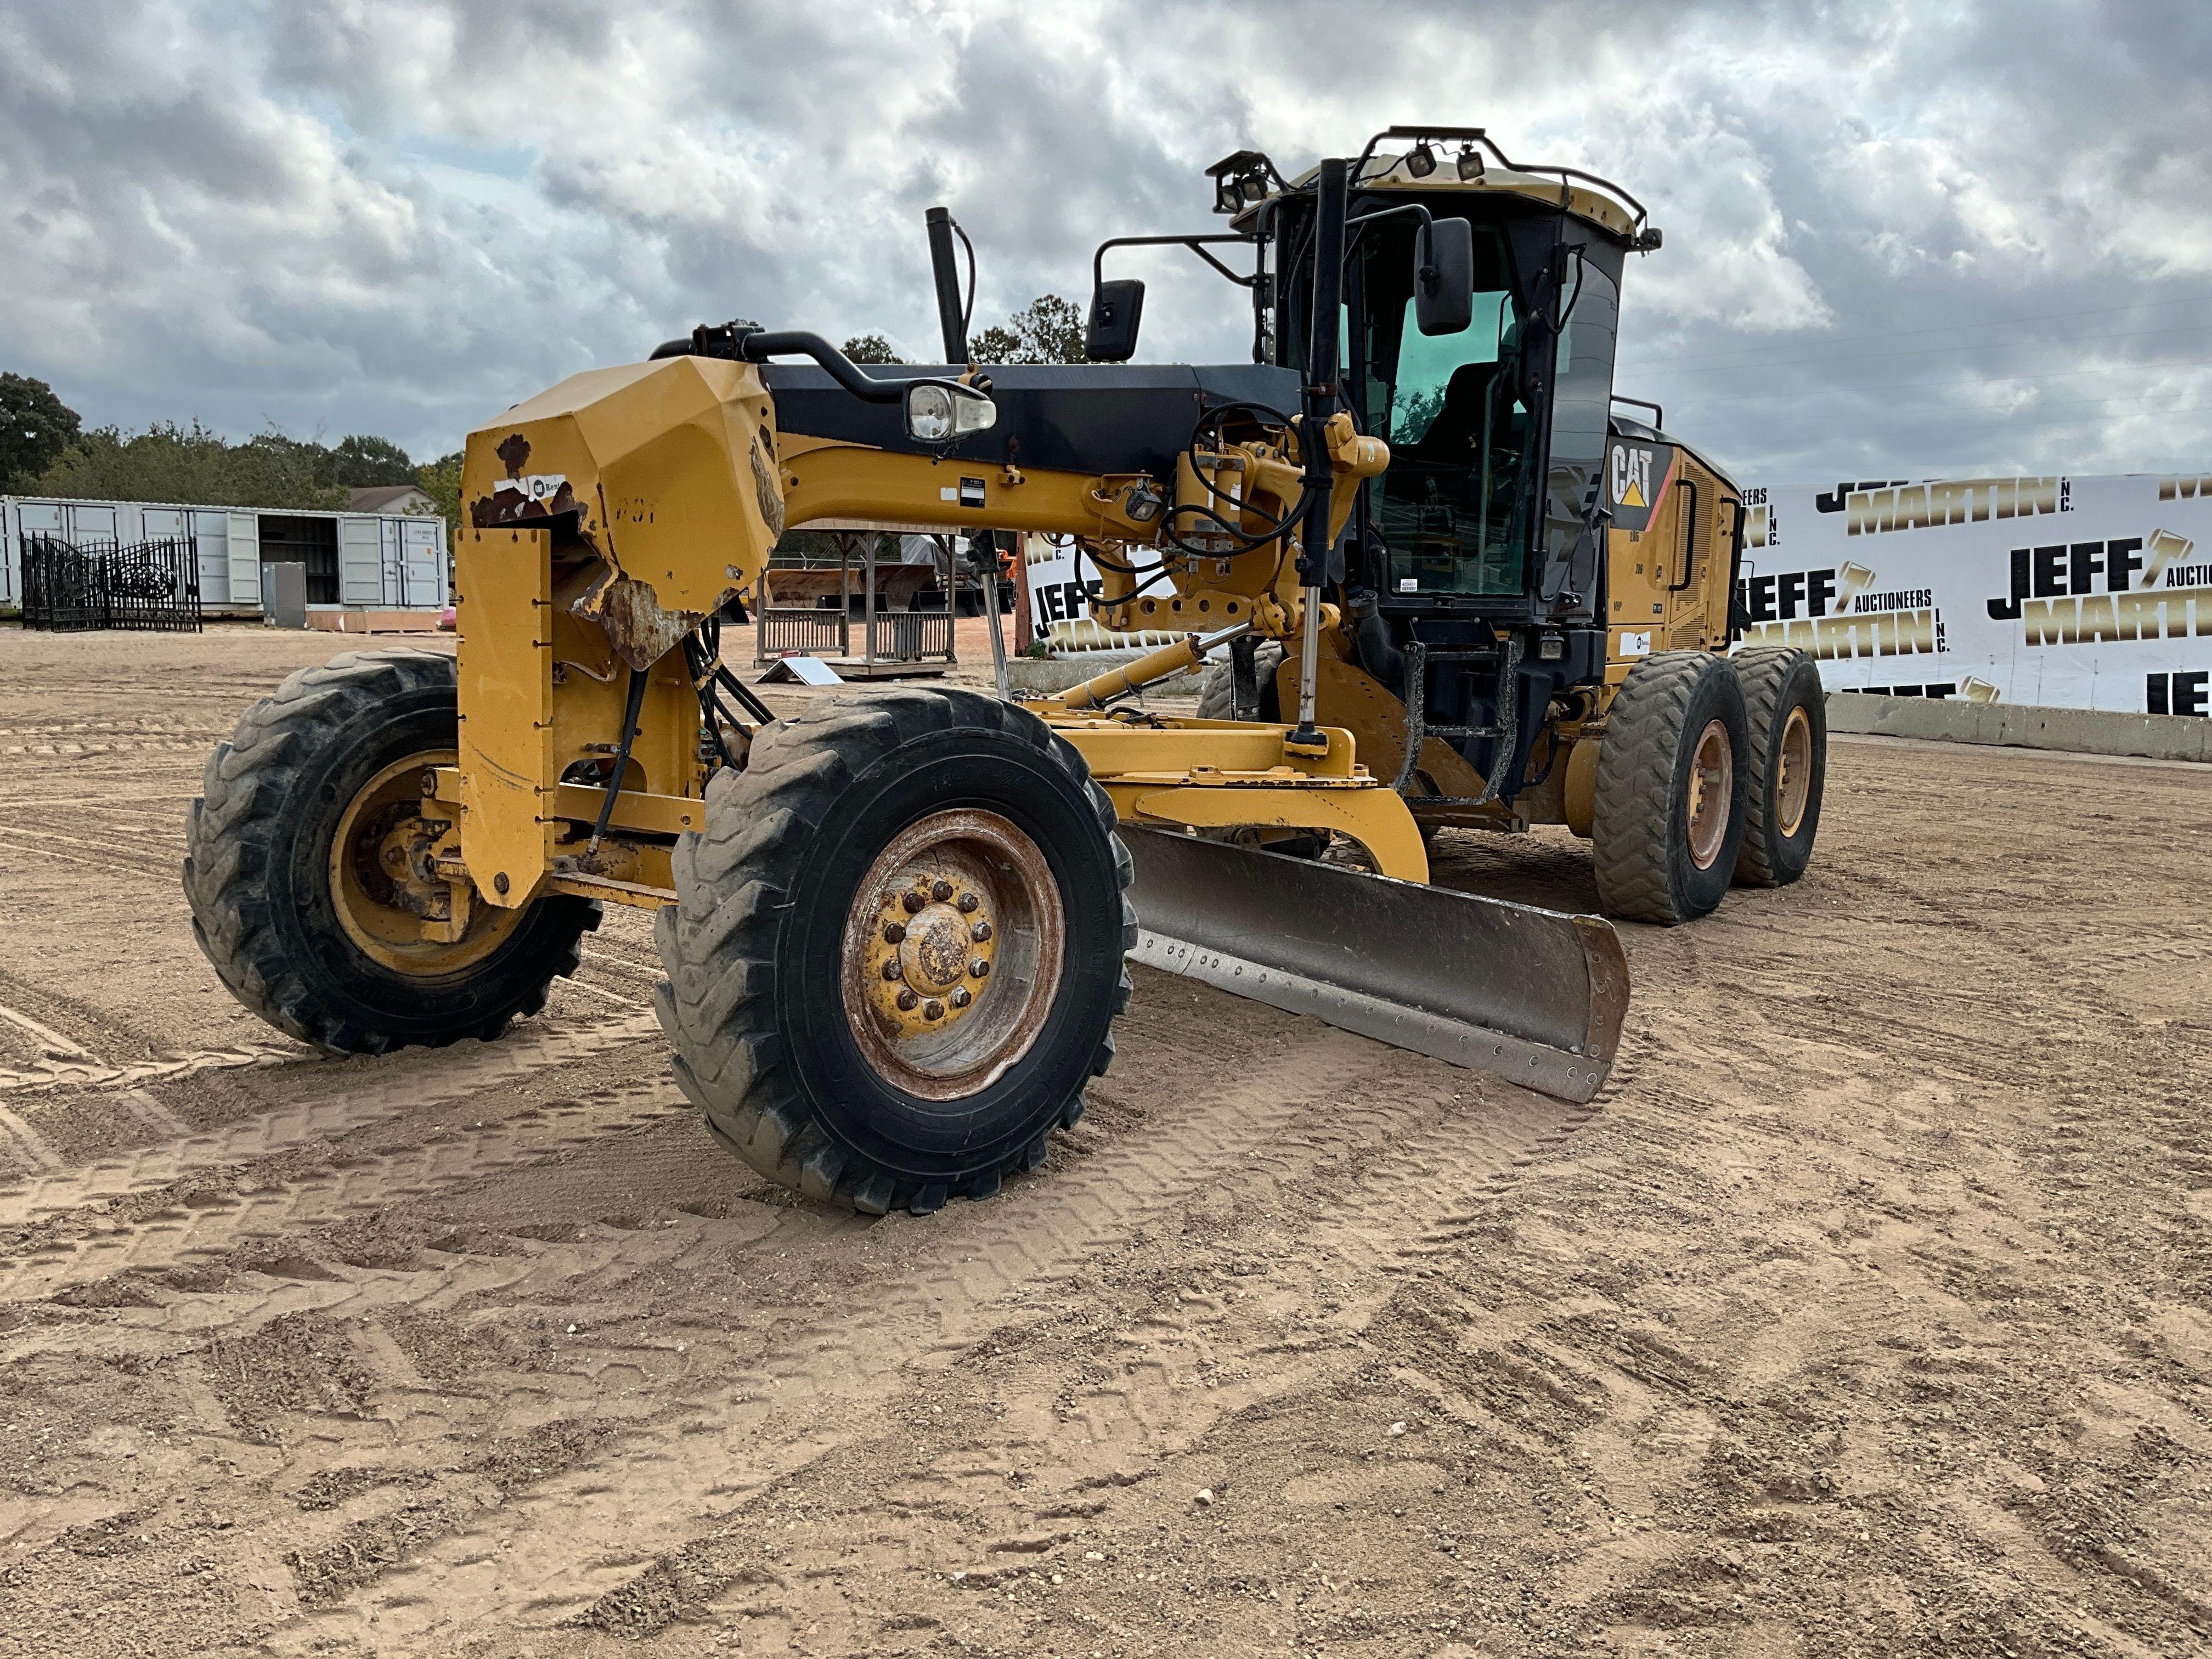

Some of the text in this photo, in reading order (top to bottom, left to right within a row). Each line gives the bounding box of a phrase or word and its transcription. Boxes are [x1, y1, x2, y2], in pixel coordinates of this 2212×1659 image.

[1612, 445, 1652, 507] CAT
[1848, 476, 2056, 537] MARTIN
[1855, 589, 1932, 613] AUCTIONEERS
[1987, 537, 2142, 620] JEFF
[1936, 608, 1950, 652] INC.
